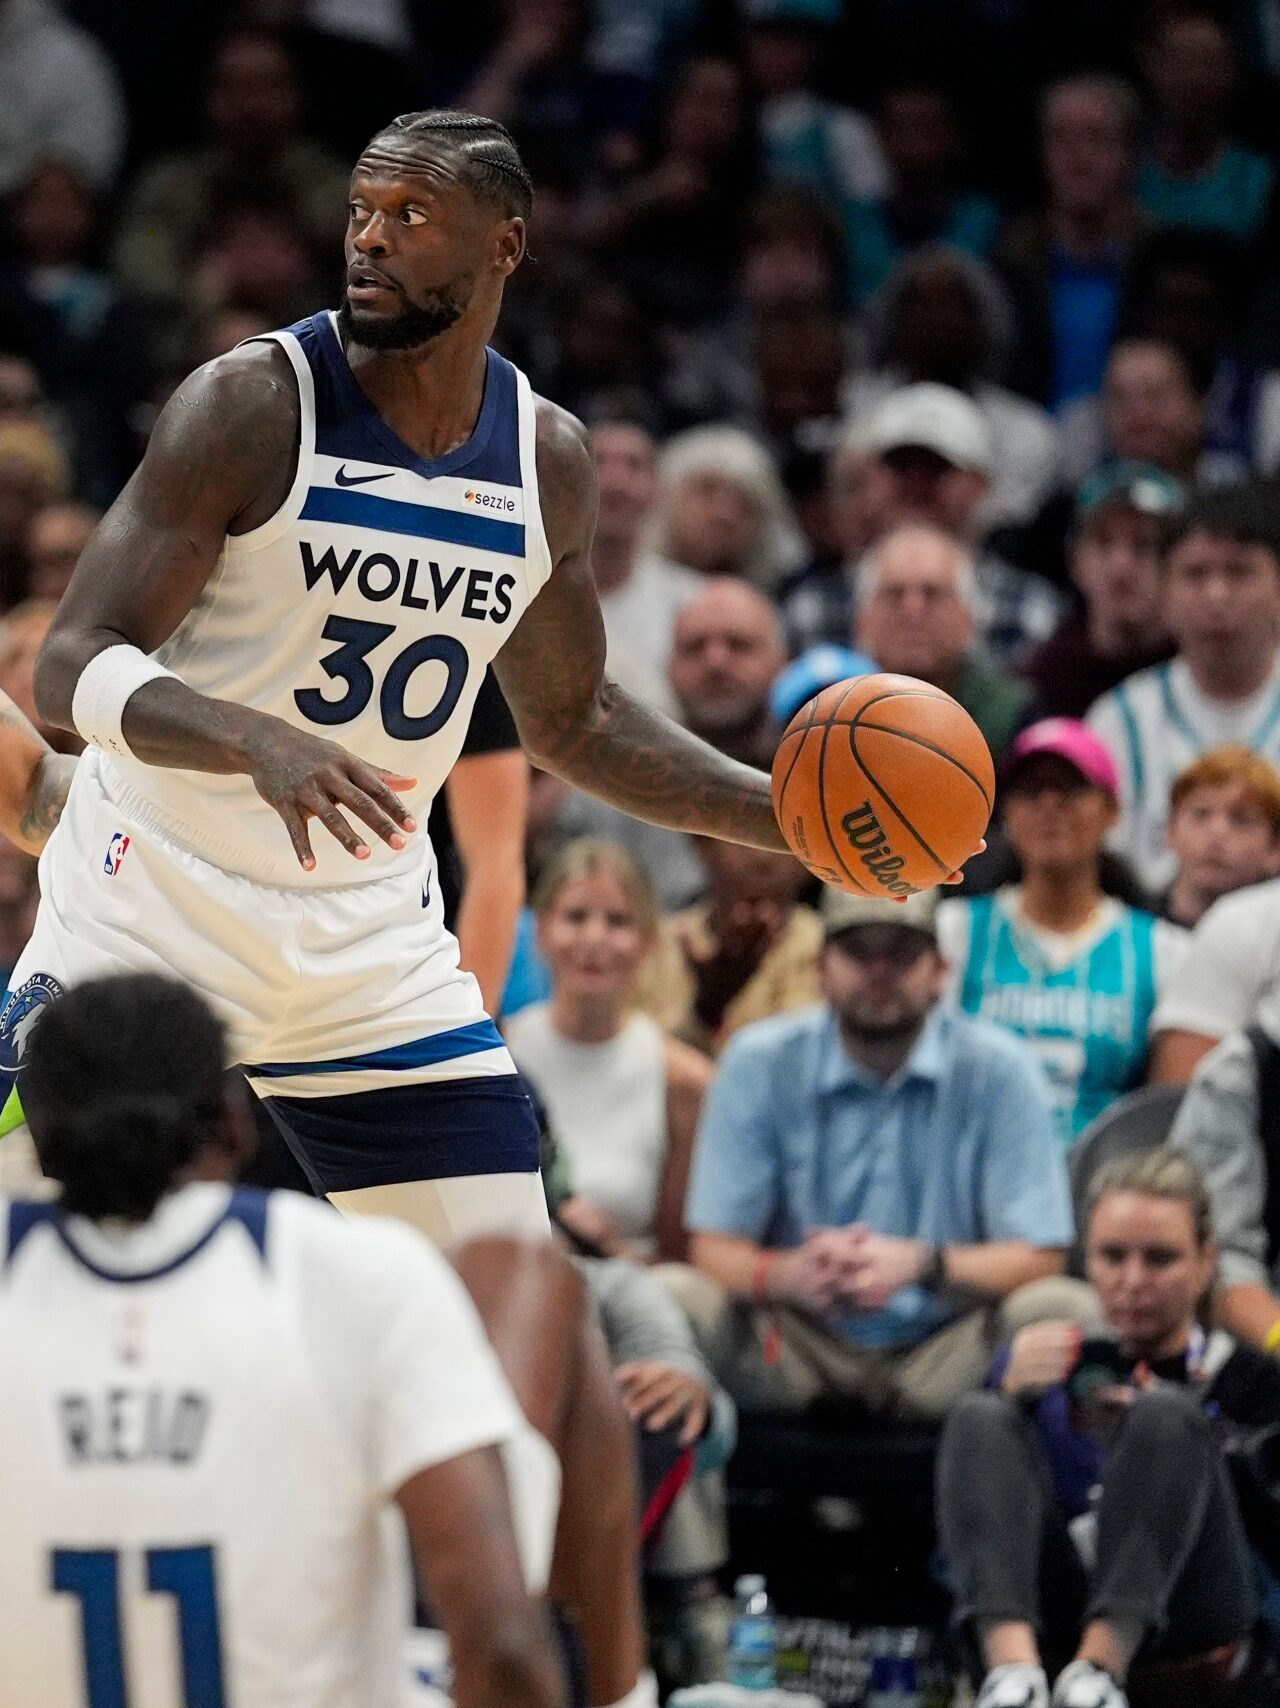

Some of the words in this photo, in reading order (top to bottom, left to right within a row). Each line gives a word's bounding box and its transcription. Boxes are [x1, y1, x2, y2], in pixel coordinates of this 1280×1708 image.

[474, 491, 516, 513] sezzle
[298, 541, 516, 624] WOLVES
[293, 613, 470, 741] 30
[48, 1545, 228, 1708] 11
